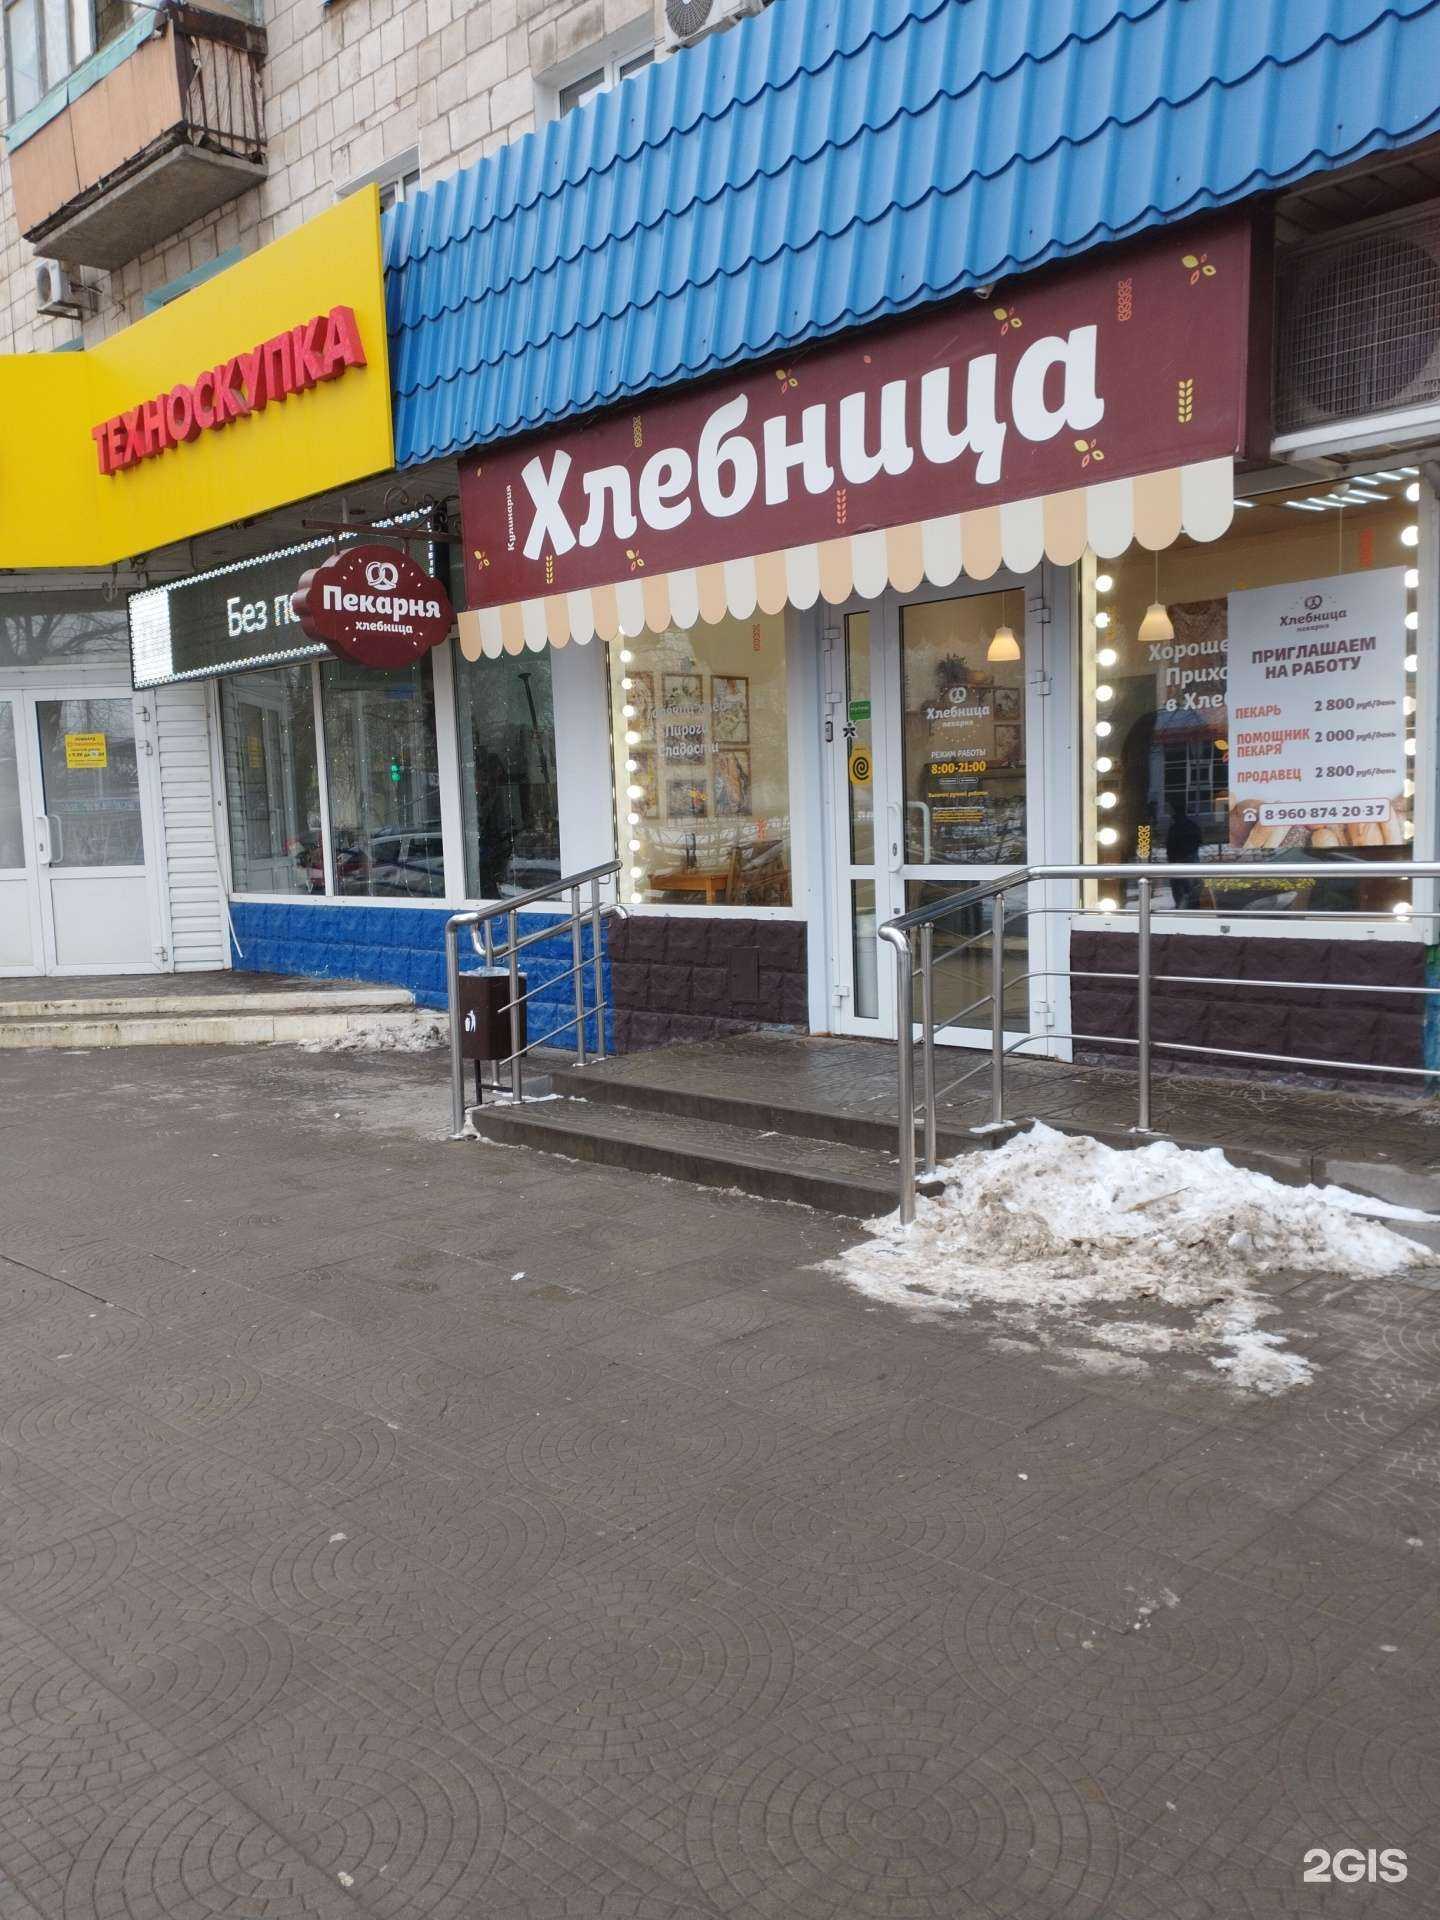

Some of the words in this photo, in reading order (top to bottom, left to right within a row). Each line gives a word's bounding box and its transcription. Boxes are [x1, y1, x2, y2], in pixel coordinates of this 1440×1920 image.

[93, 305, 367, 476] ТЕХНОСКУПКА
[521, 324, 1105, 561] Хлебница
[323, 584, 441, 622] Пекарня
[226, 597, 267, 637] Без
[1280, 609, 1347, 627] Хлебница
[355, 620, 413, 634] хлебница
[1251, 636, 1377, 665] ПРИГЛАШАЕМ
[1265, 664, 1289, 680] НА
[1291, 655, 1362, 677] РАБОТУ
[1235, 704, 1282, 720] ПЕКАРЬ
[1326, 697, 1355, 711] 800
[926, 705, 990, 720] Хлебница
[1237, 728, 1311, 745] ПОМОЩНИК
[1326, 729, 1355, 742] 000
[957, 748, 986, 758] РАБОТЫ
[1237, 744, 1283, 758] ПЕКАРЯ
[1237, 768, 1302, 784] ПРОДАВЕЦ
[1326, 765, 1355, 778] 800
